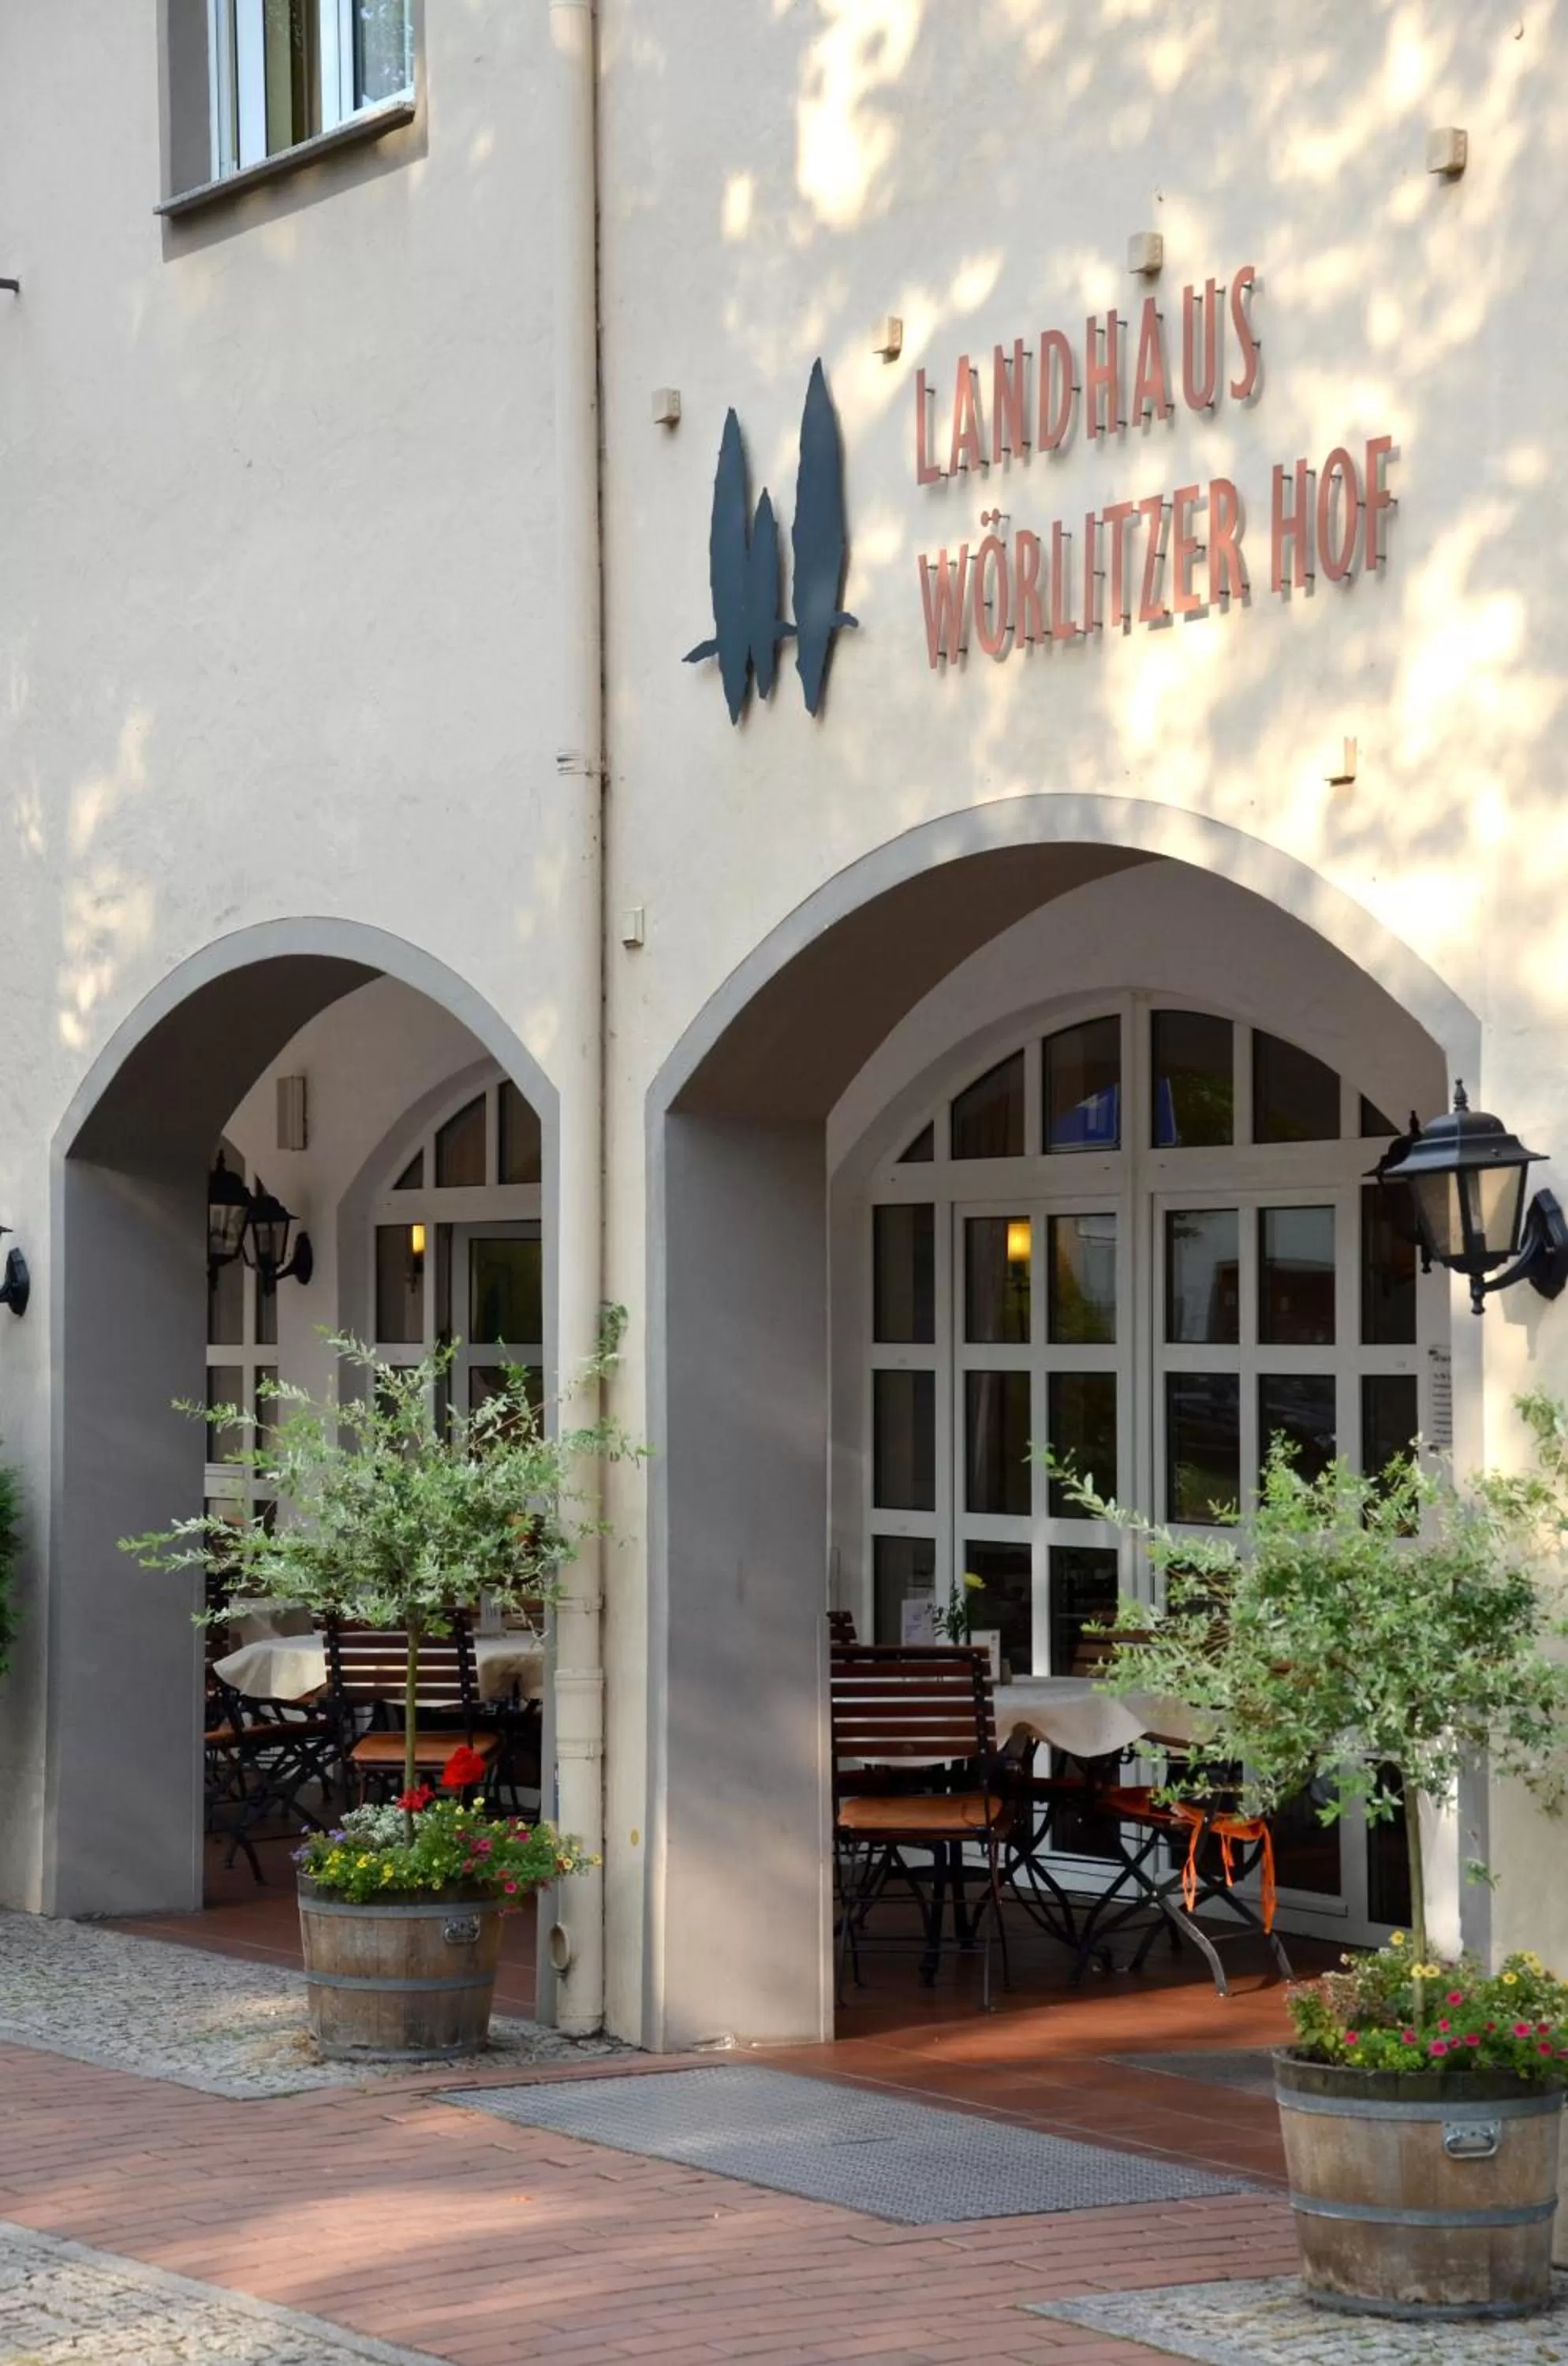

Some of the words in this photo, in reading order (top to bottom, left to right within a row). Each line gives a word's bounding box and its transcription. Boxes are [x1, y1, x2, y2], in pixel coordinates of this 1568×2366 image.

[917, 266, 1258, 485] LANDHAUS
[918, 478, 1249, 669] WÖRLITZER
[1271, 435, 1392, 593] HOF
